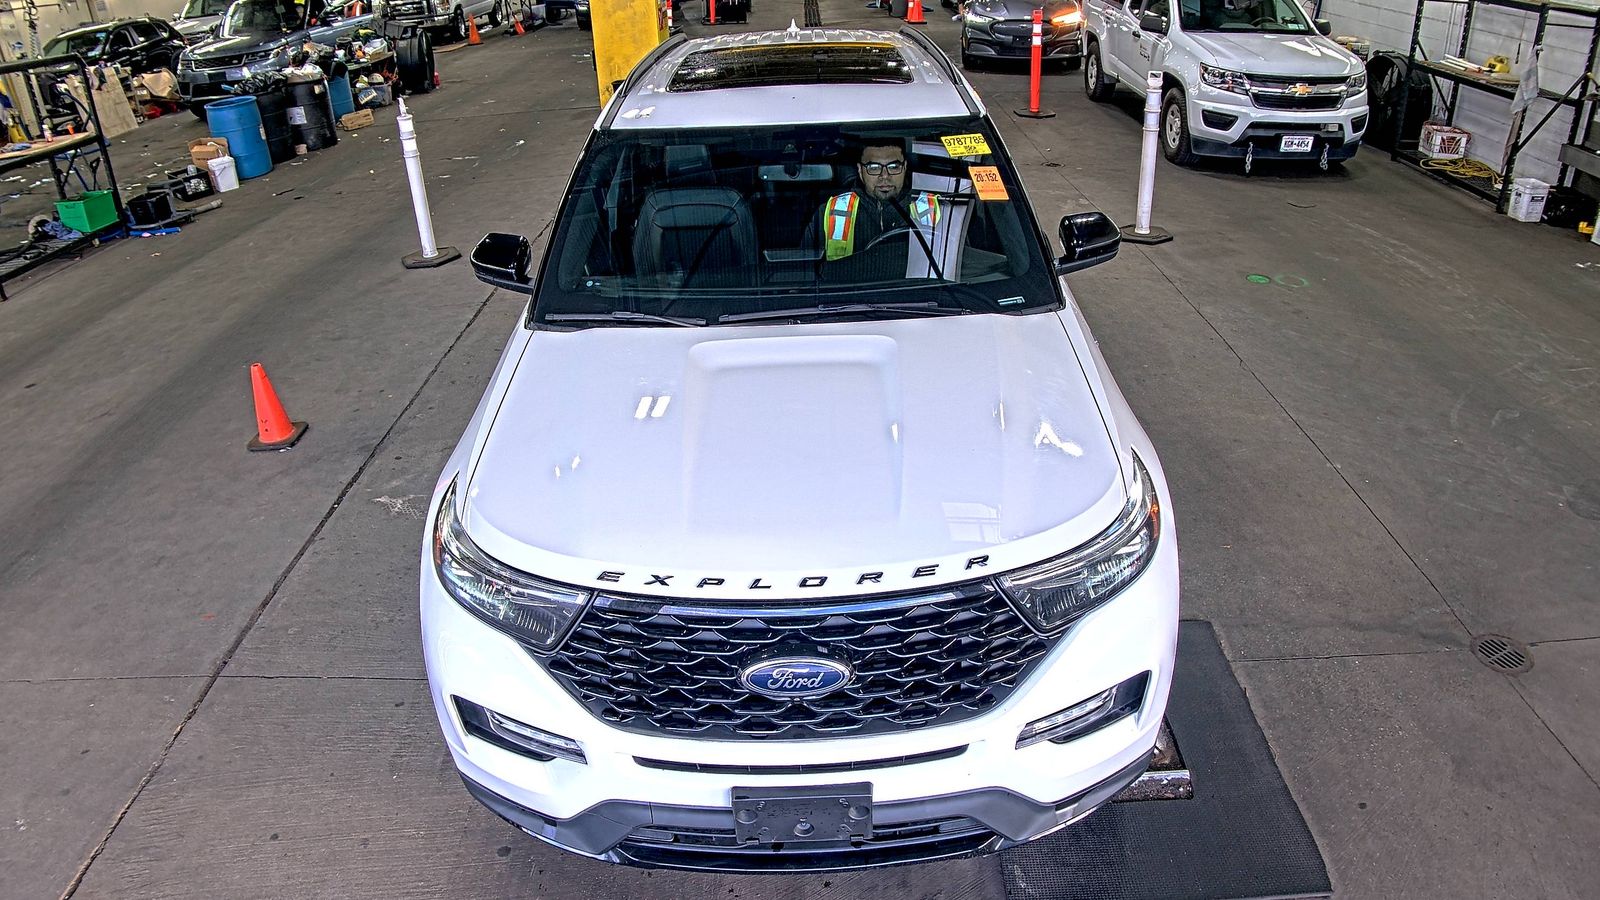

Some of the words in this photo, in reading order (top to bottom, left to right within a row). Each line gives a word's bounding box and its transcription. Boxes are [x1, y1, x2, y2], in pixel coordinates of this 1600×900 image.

[944, 135, 986, 147] 9787785
[596, 554, 990, 590] EXPLORER
[767, 667, 824, 689] Ford
